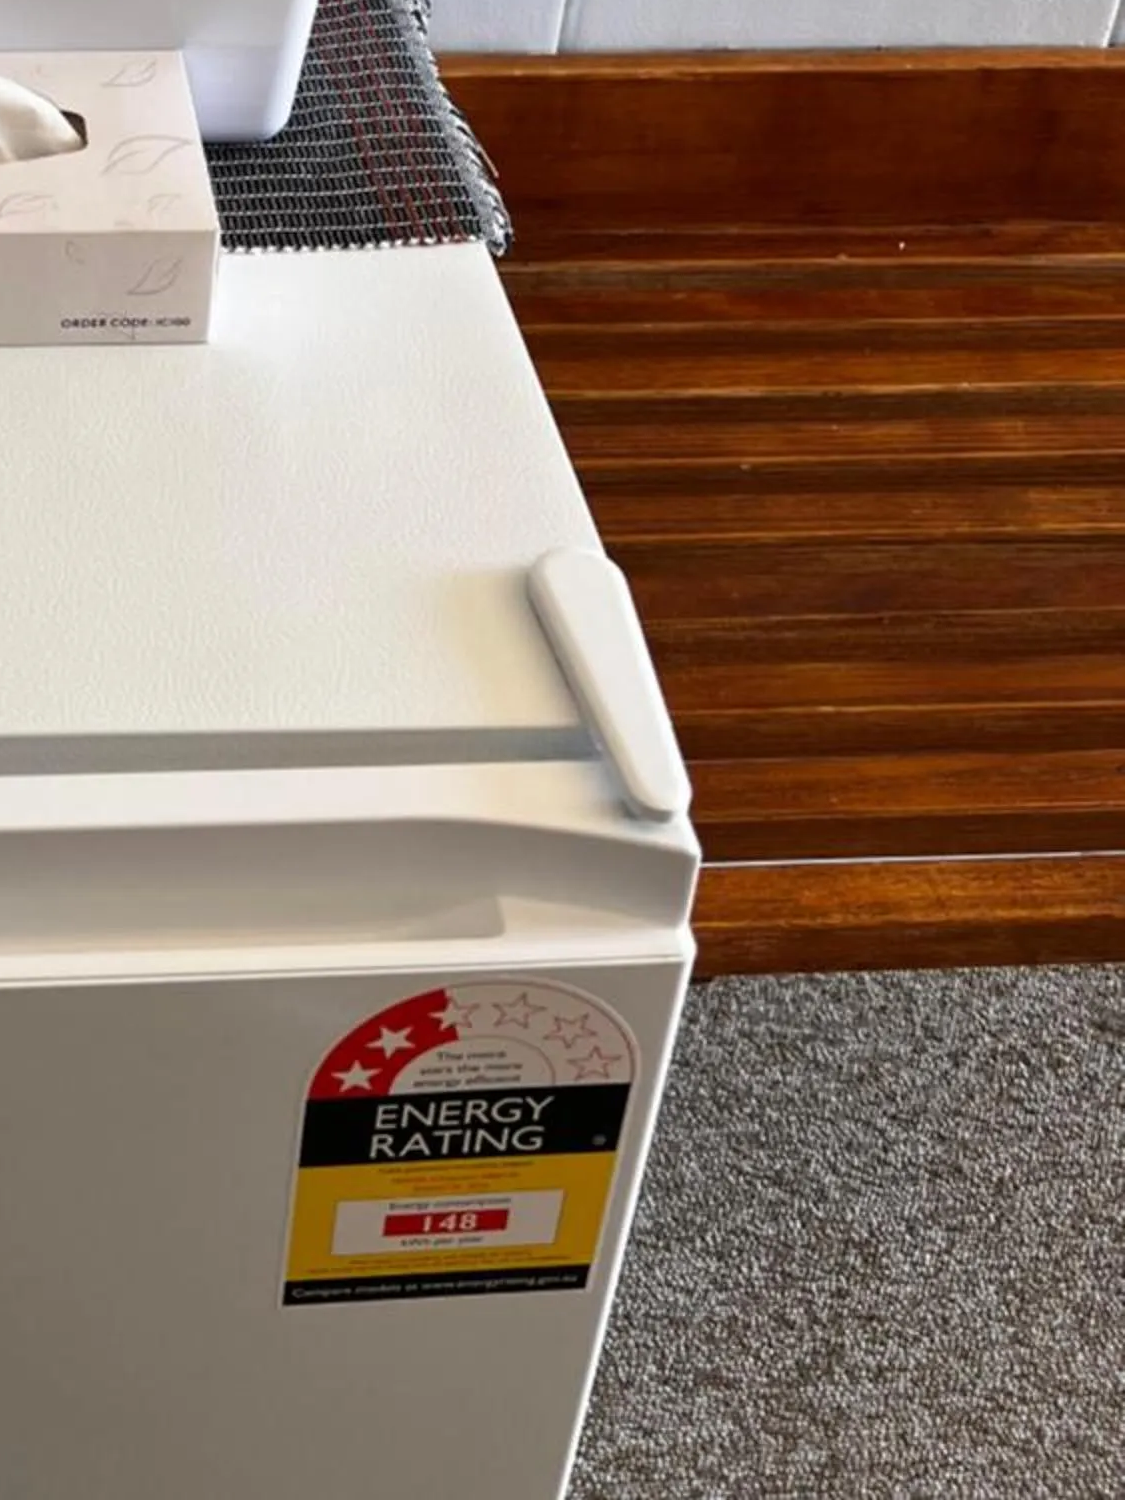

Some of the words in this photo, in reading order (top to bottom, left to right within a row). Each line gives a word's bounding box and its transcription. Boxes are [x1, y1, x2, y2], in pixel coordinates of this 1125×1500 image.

[61, 317, 108, 329] ORDER
[375, 1095, 556, 1131] ENERGY
[369, 1125, 545, 1160] RATING
[424, 1211, 479, 1233] 148
